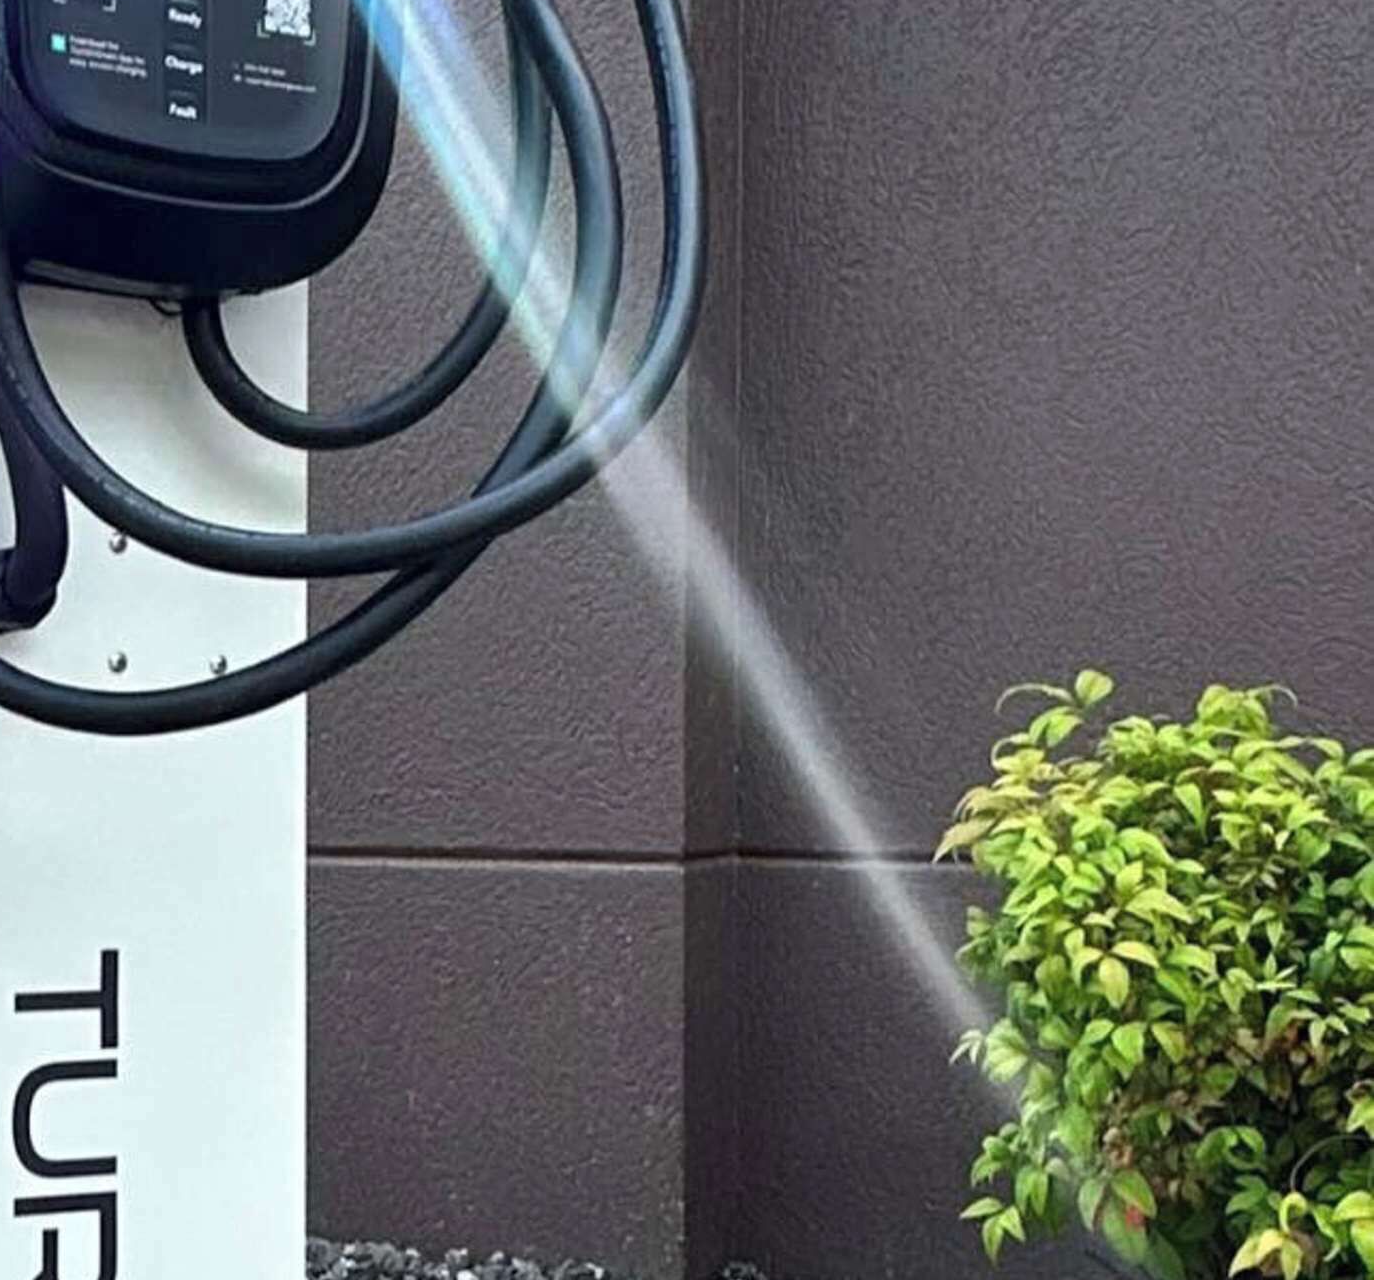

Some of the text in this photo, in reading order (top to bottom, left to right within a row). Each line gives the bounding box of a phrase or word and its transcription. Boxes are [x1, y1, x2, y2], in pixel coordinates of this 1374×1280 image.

[168, 8, 202, 29] Ready
[165, 55, 203, 75] Charge
[169, 103, 197, 119] Fault
